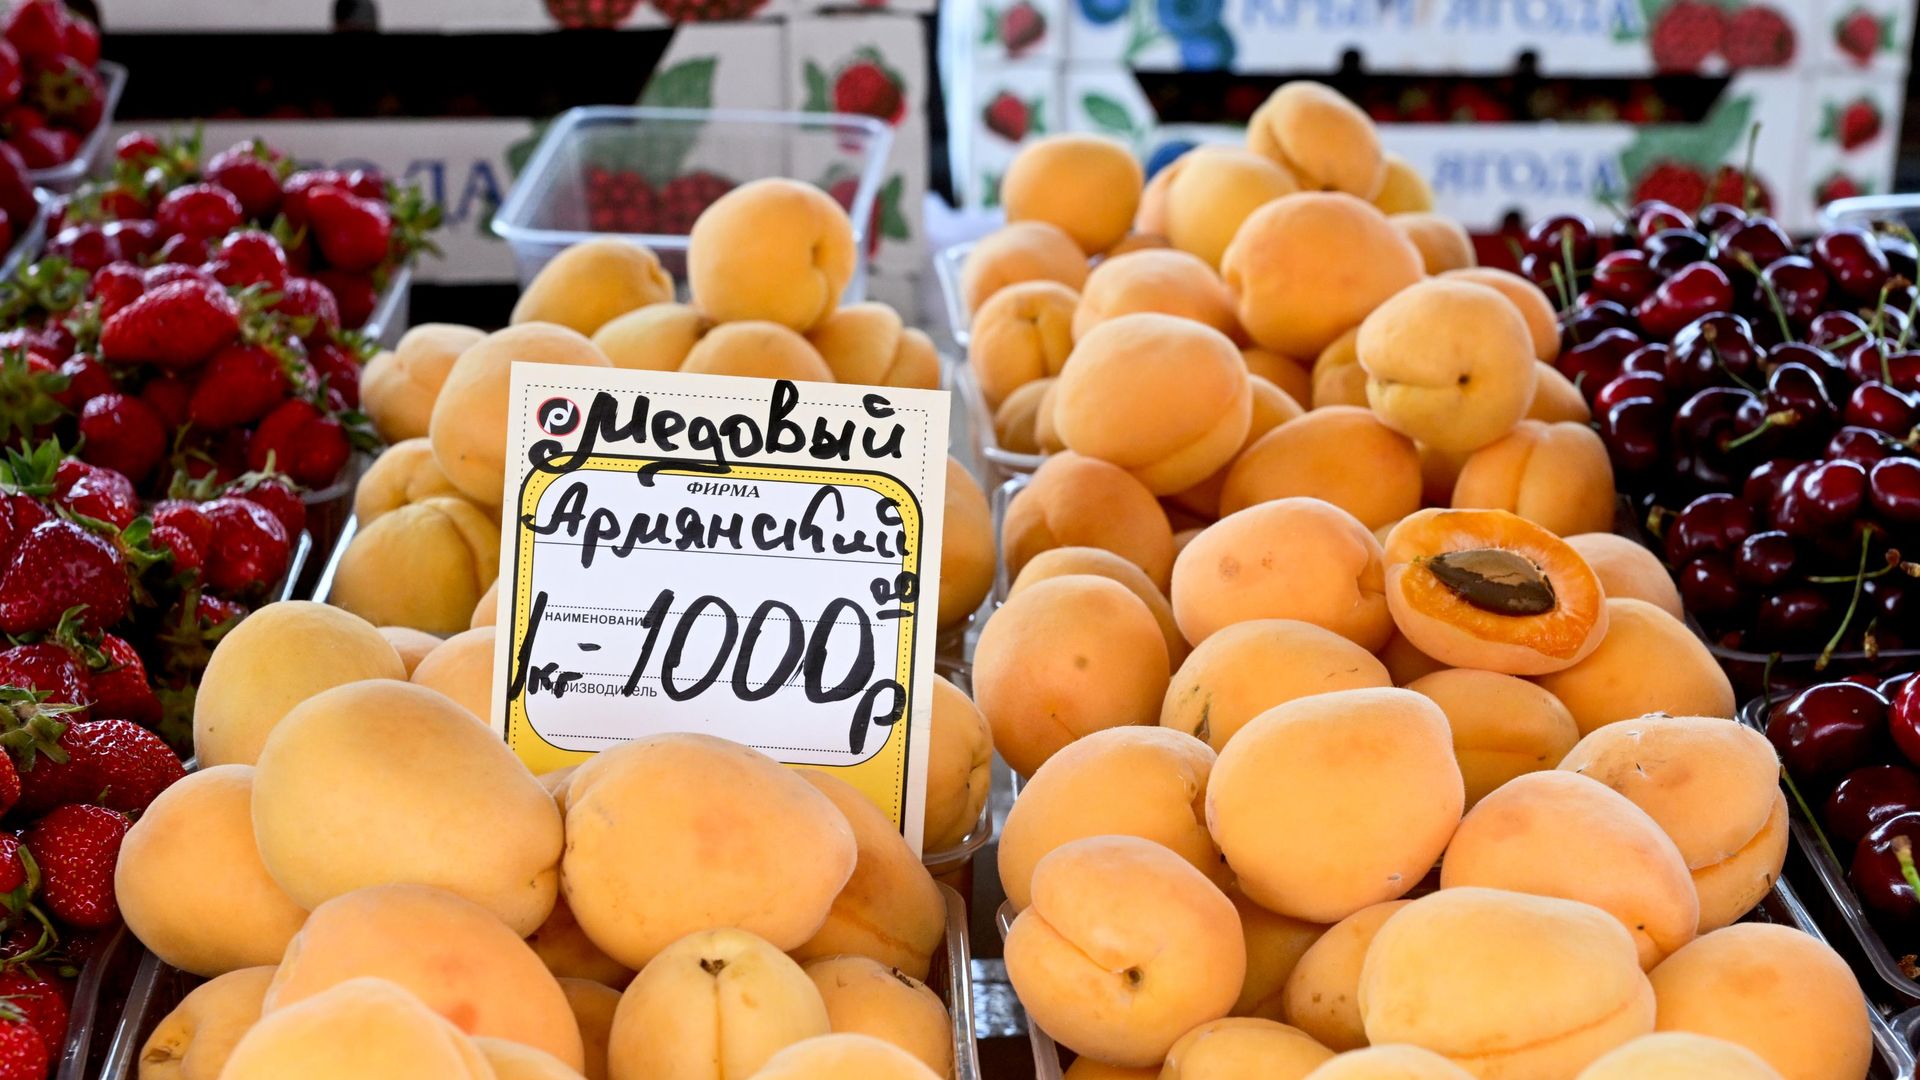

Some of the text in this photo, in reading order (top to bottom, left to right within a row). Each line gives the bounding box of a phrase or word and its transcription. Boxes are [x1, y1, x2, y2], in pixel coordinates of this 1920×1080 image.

[528, 380, 906, 487] Медовый
[687, 481, 760, 498] ФИРМА
[521, 482, 910, 568] Армянский
[544, 612, 653, 628] НАИМЕНОВАНИ
[540, 680, 657, 698] оизводиель
